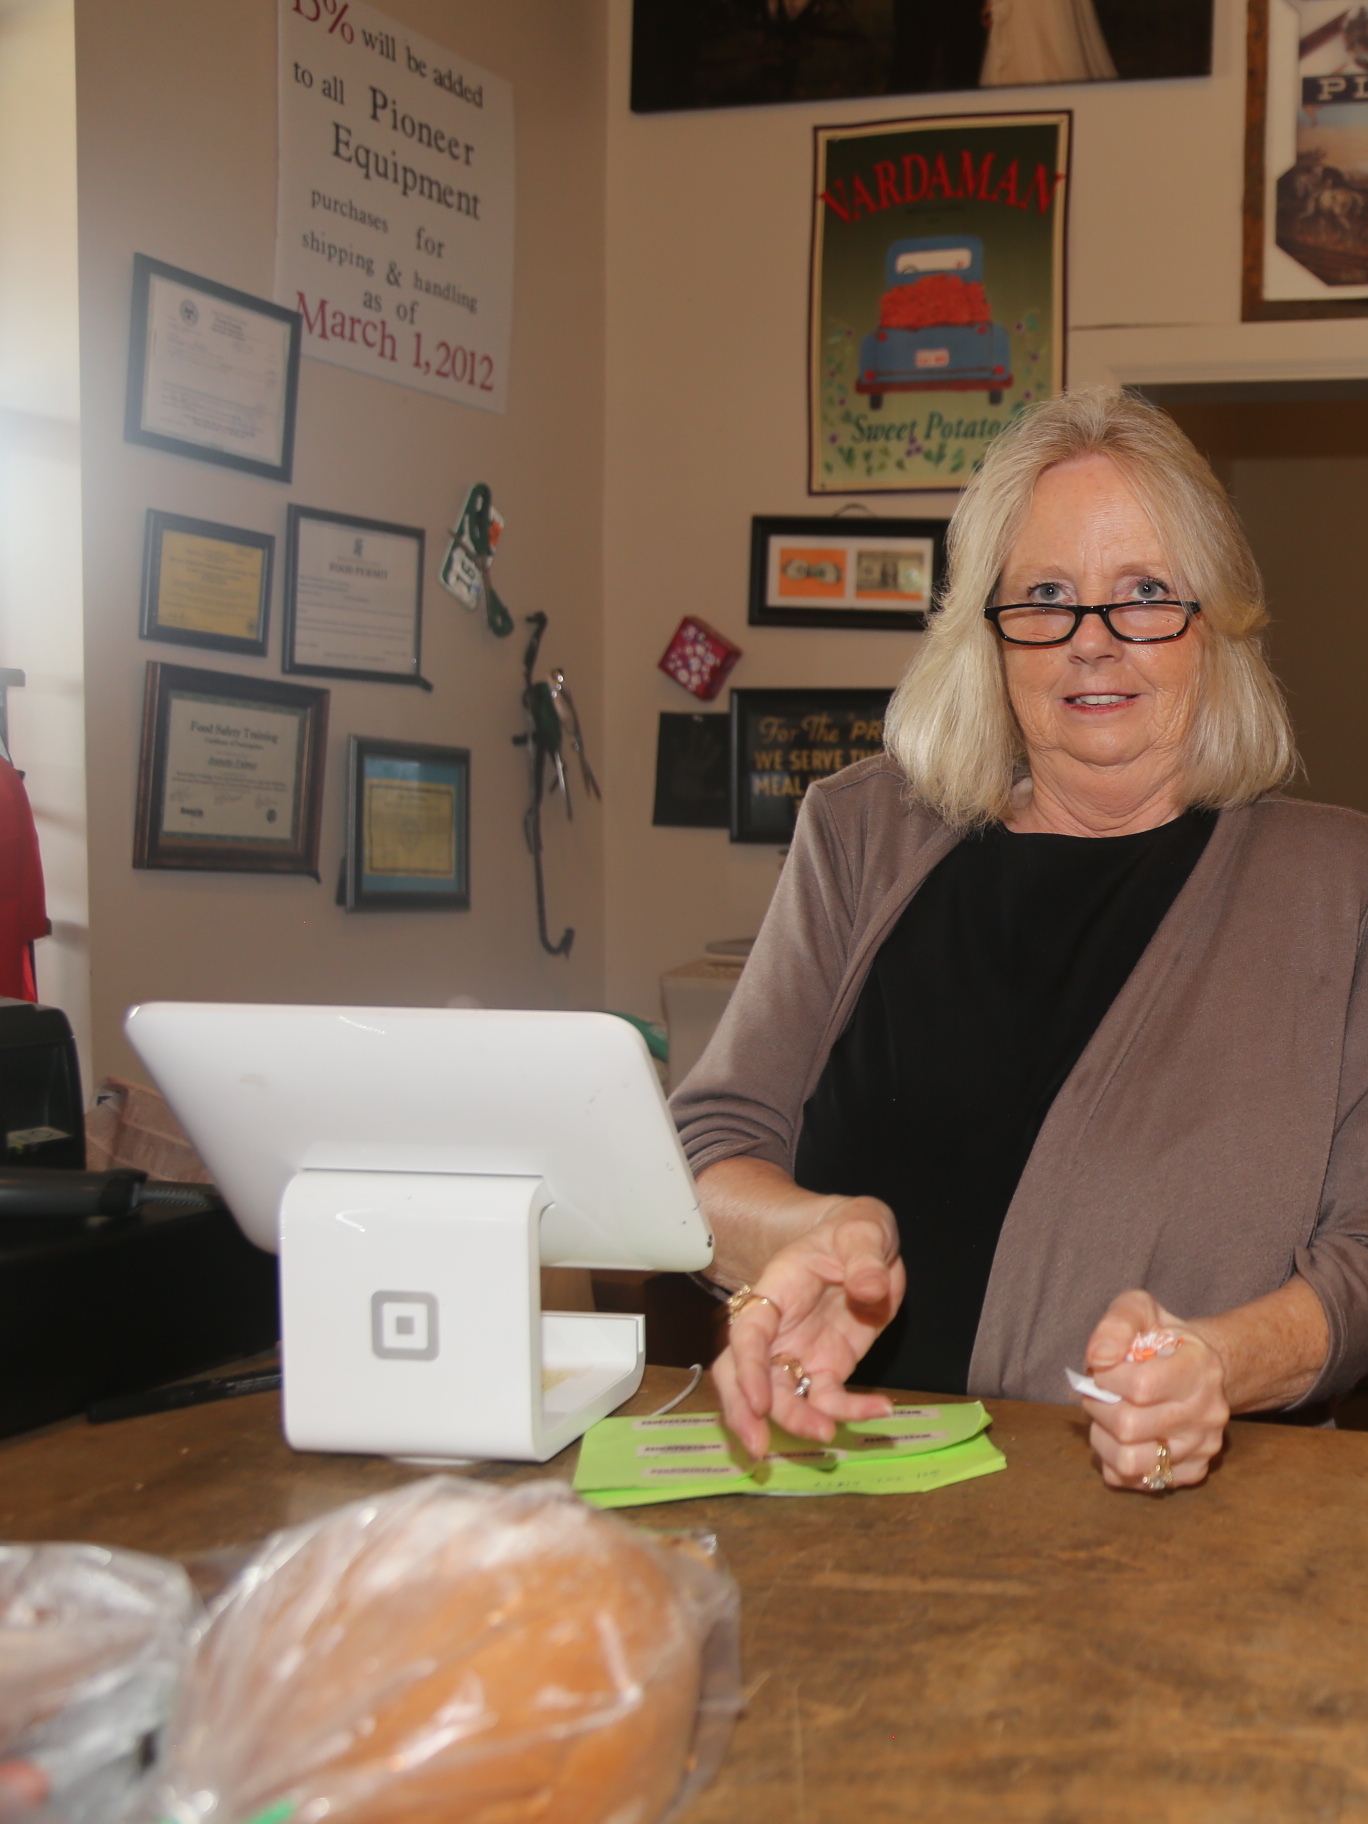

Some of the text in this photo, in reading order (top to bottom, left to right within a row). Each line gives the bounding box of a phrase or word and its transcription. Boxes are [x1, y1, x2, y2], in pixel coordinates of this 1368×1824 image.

[362, 28, 396, 62] will
[406, 45, 428, 79] be
[433, 67, 484, 109] added
[294, 62, 475, 167] to all Pioneer
[332, 121, 481, 220] Equipment
[819, 149, 1066, 225] VARDAMAN
[311, 189, 445, 259] purchases for
[302, 230, 478, 315] shipping & handling
[363, 289, 419, 325] as of
[296, 291, 494, 393] March 1,2012
[851, 410, 1005, 444] Sweet Potato
[328, 562, 389, 580] FOOD PERMIT
[190, 720, 279, 744] Food Safety Training
[758, 715, 799, 745] For
[801, 712, 840, 743] The
[753, 750, 784, 770] WE
[789, 749, 844, 771] SERVE
[753, 774, 805, 796] MEAL
